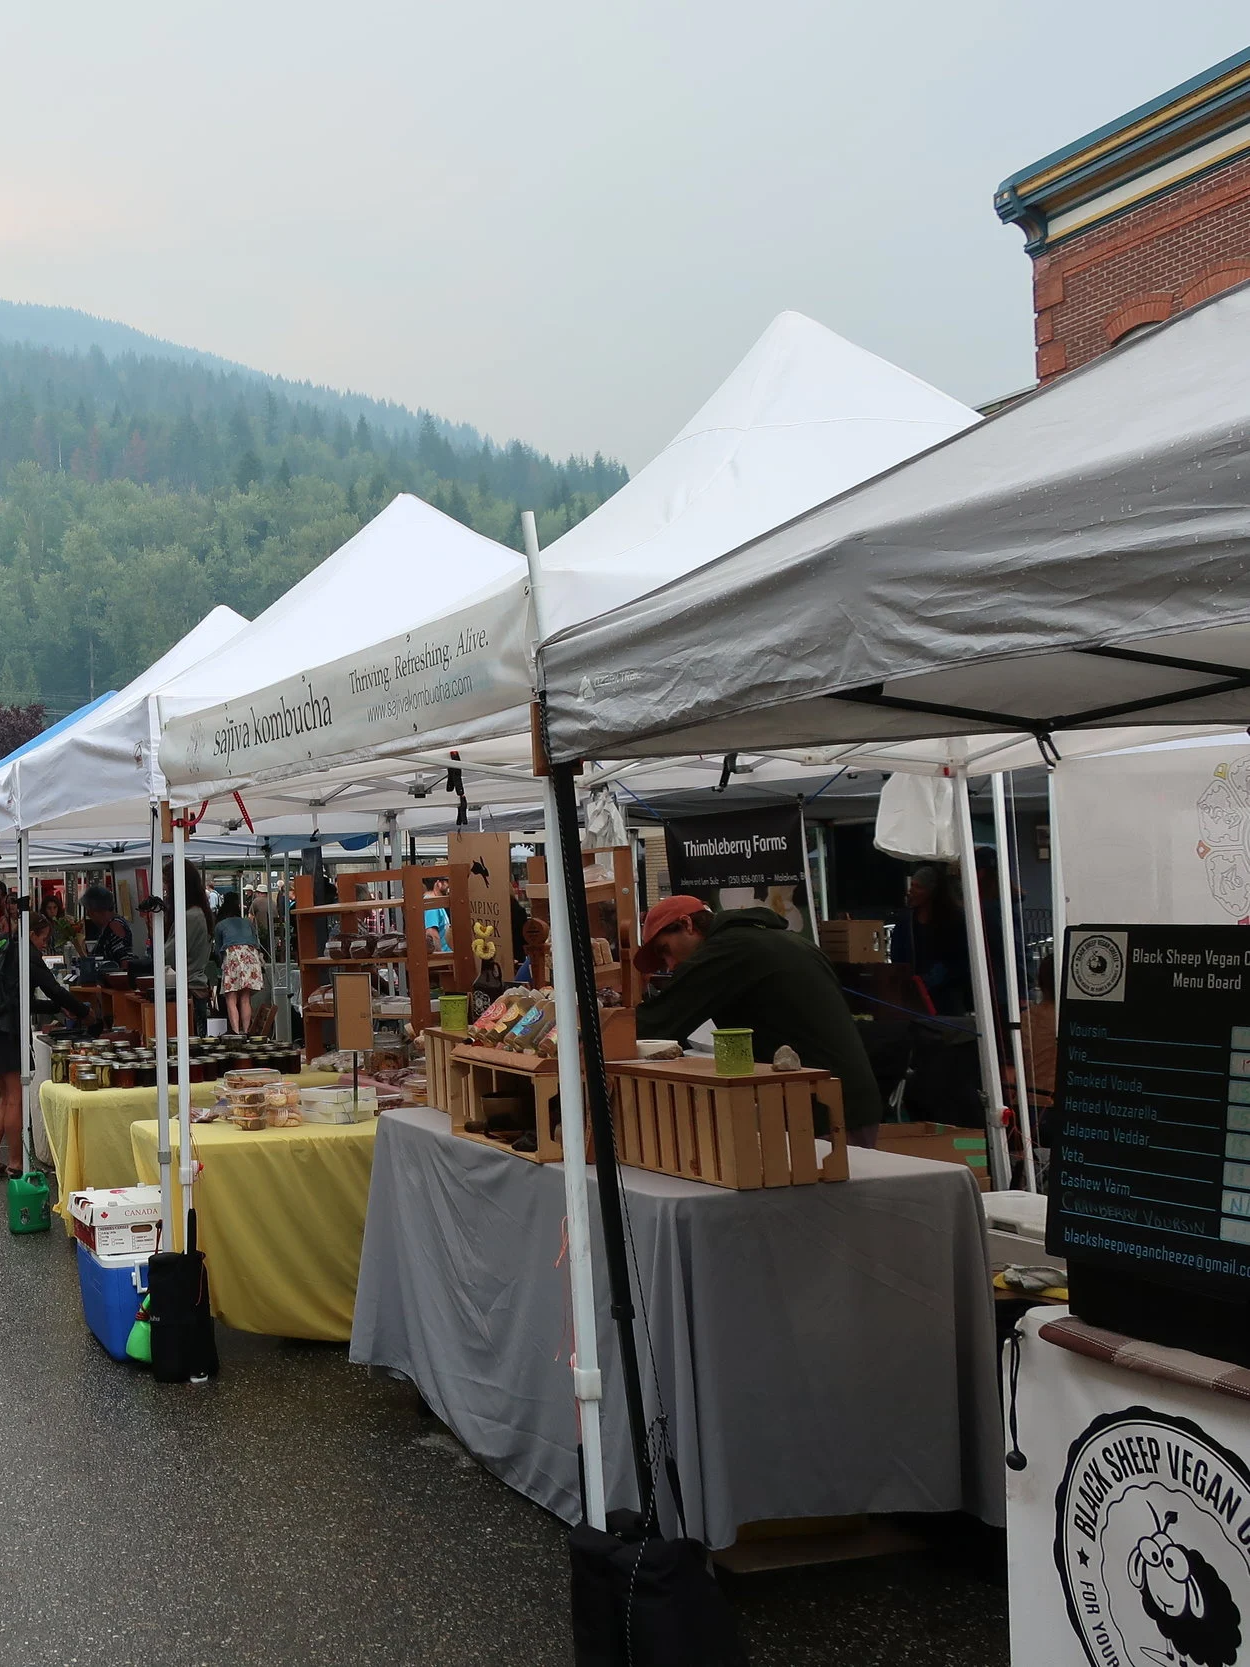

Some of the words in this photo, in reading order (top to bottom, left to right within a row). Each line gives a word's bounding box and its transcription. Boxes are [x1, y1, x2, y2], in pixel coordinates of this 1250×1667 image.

[349, 666, 392, 696] Thriving.
[394, 641, 453, 679] Refreshing.
[455, 627, 489, 658] Alive.
[366, 673, 473, 724] www.sajivakombucha.com
[251, 683, 333, 747] kombucha
[683, 837, 751, 859] Thimbleberry
[753, 834, 787, 852] Farms
[728, 876, 740, 885] (250)
[1133, 949, 1163, 965] Black
[1166, 949, 1201, 968] Sheep
[1205, 951, 1241, 969] Vegan
[1173, 974, 1203, 989] Menu
[1207, 974, 1241, 991] Board
[1069, 1021, 1107, 1038] Voursin
[1068, 1046, 1087, 1062] Vrie
[1066, 1070, 1107, 1090] Smoked
[1111, 1074, 1143, 1093] Vouda
[1065, 1096, 1102, 1114] Herbed
[1104, 1099, 1157, 1121] Vozzarella
[1062, 1121, 1109, 1141] Jalapeno
[1112, 1126, 1150, 1146] Veddar
[1061, 1145, 1084, 1163] Veta
[1060, 1171, 1101, 1191] Cashew
[1104, 1177, 1131, 1196] Varm
[124, 1208, 158, 1217] CANADA
[1073, 1457, 1113, 1542] BLACK
[1102, 1437, 1161, 1483] SHEEP
[1166, 1441, 1243, 1525] VEGAN
[1079, 1579, 1100, 1615] FOR
[1092, 1620, 1121, 1667] YOUR
